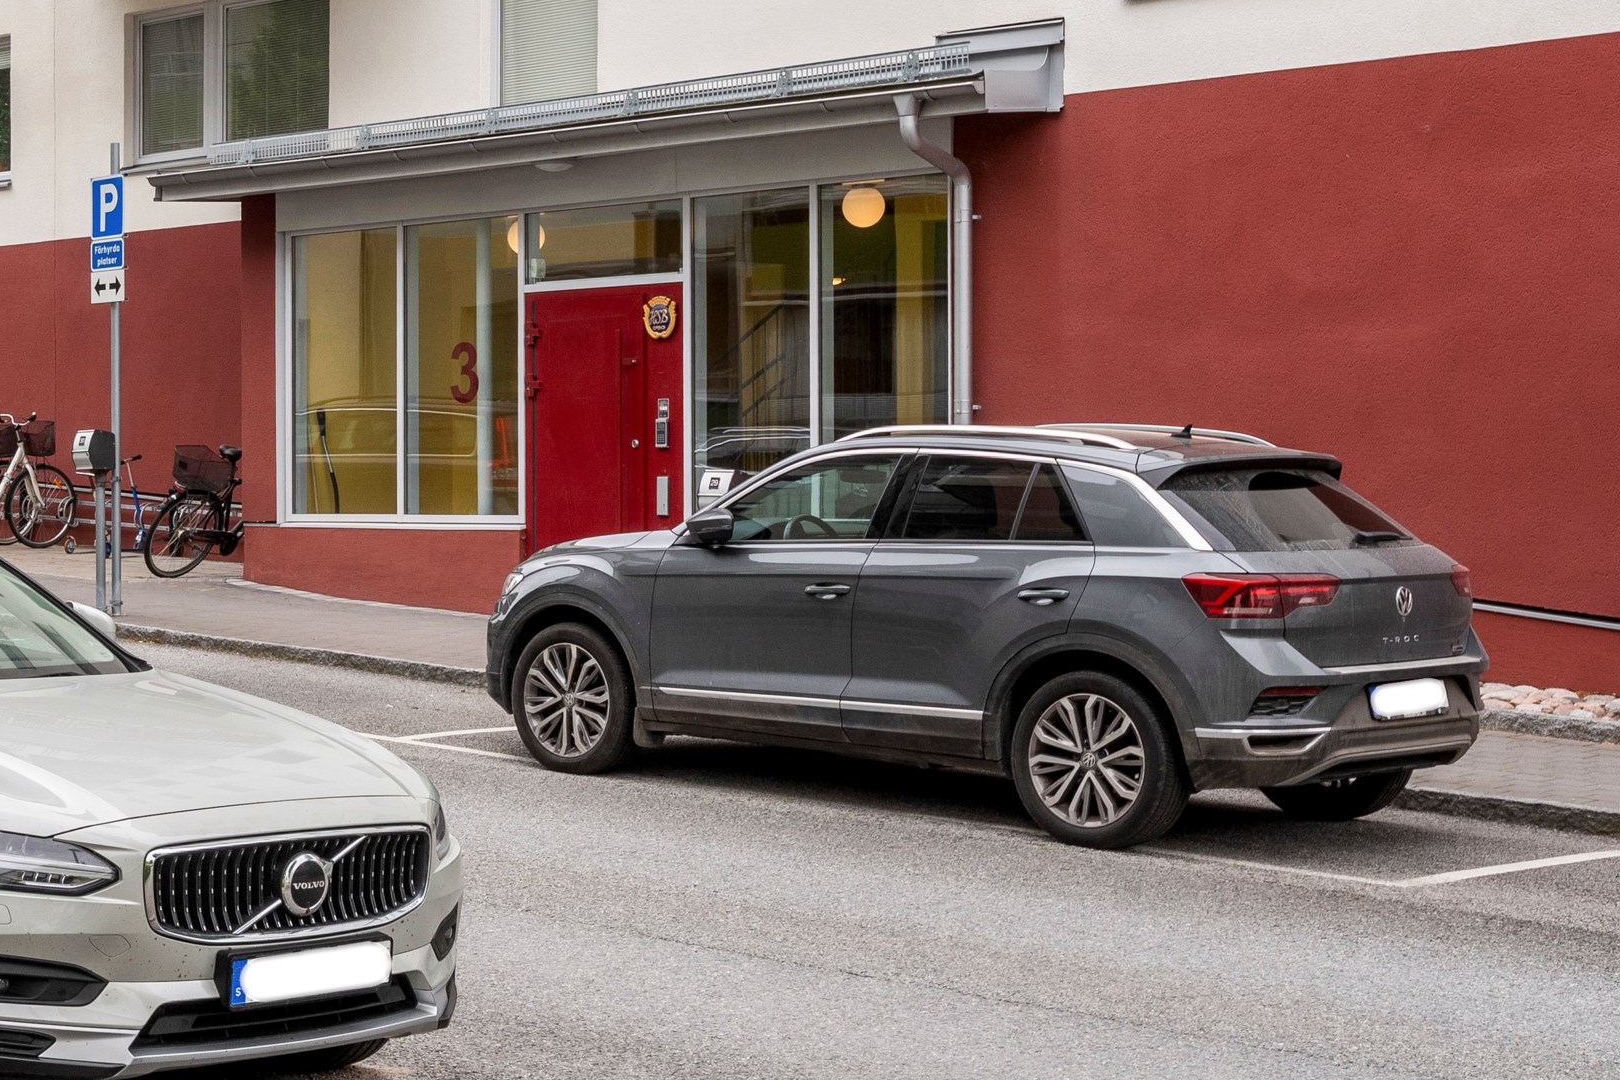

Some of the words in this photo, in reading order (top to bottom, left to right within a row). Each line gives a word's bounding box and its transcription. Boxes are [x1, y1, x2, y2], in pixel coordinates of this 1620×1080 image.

[100, 183, 118, 232] P
[94, 244, 120, 255] Förhyrda
[97, 257, 117, 268] platser
[450, 342, 479, 404] 3
[1382, 634, 1420, 644] T-ROC
[293, 880, 325, 890] VOLVO
[235, 986, 242, 997] S
